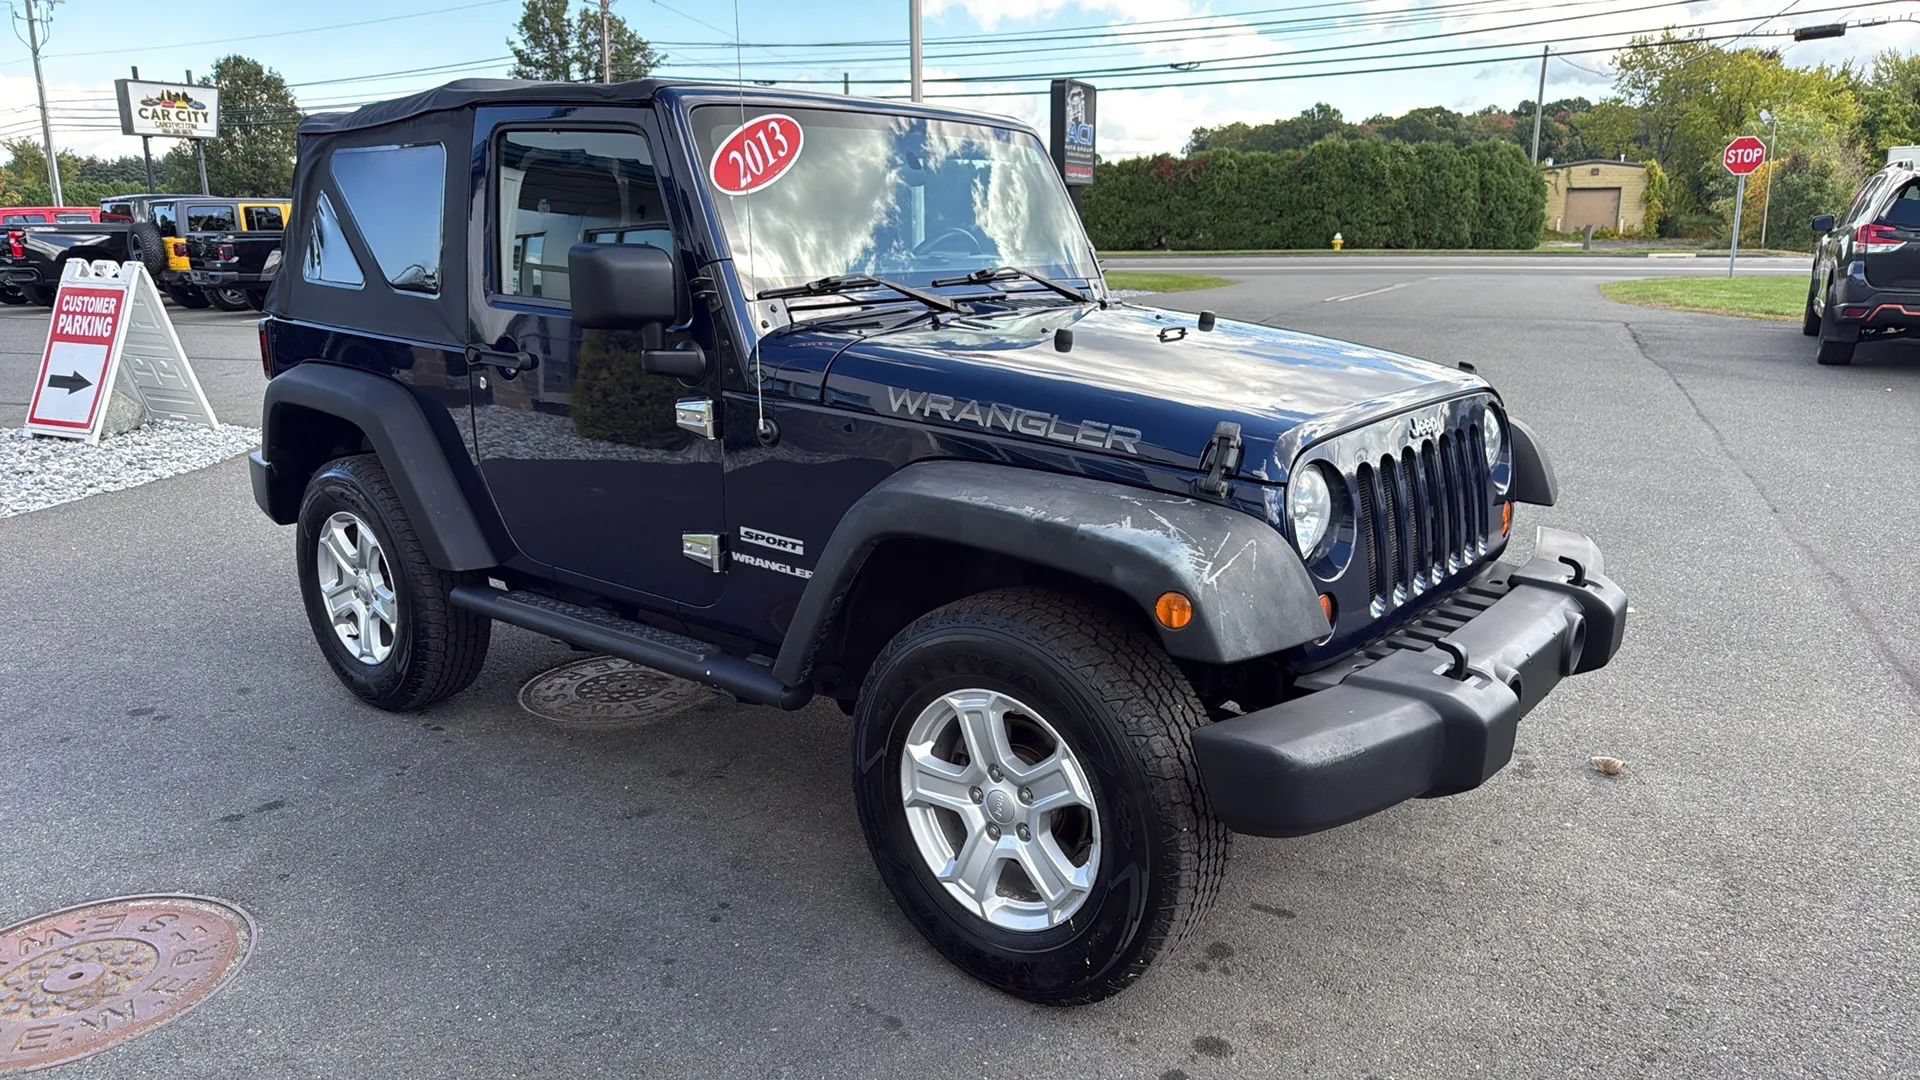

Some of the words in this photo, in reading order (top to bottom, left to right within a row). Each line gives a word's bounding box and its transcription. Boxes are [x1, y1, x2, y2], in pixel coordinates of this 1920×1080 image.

[138, 107, 171, 121] CAR
[175, 109, 209, 123] CITY
[728, 121, 789, 189] 2013
[1727, 148, 1762, 163] STOP
[62, 295, 117, 315] CUSTOMER
[56, 313, 113, 337] PARKING
[887, 386, 1142, 455] WRANGLER
[1409, 417, 1438, 439] Jeep
[743, 530, 799, 551] SPORT
[731, 551, 814, 579] WRANGLER
